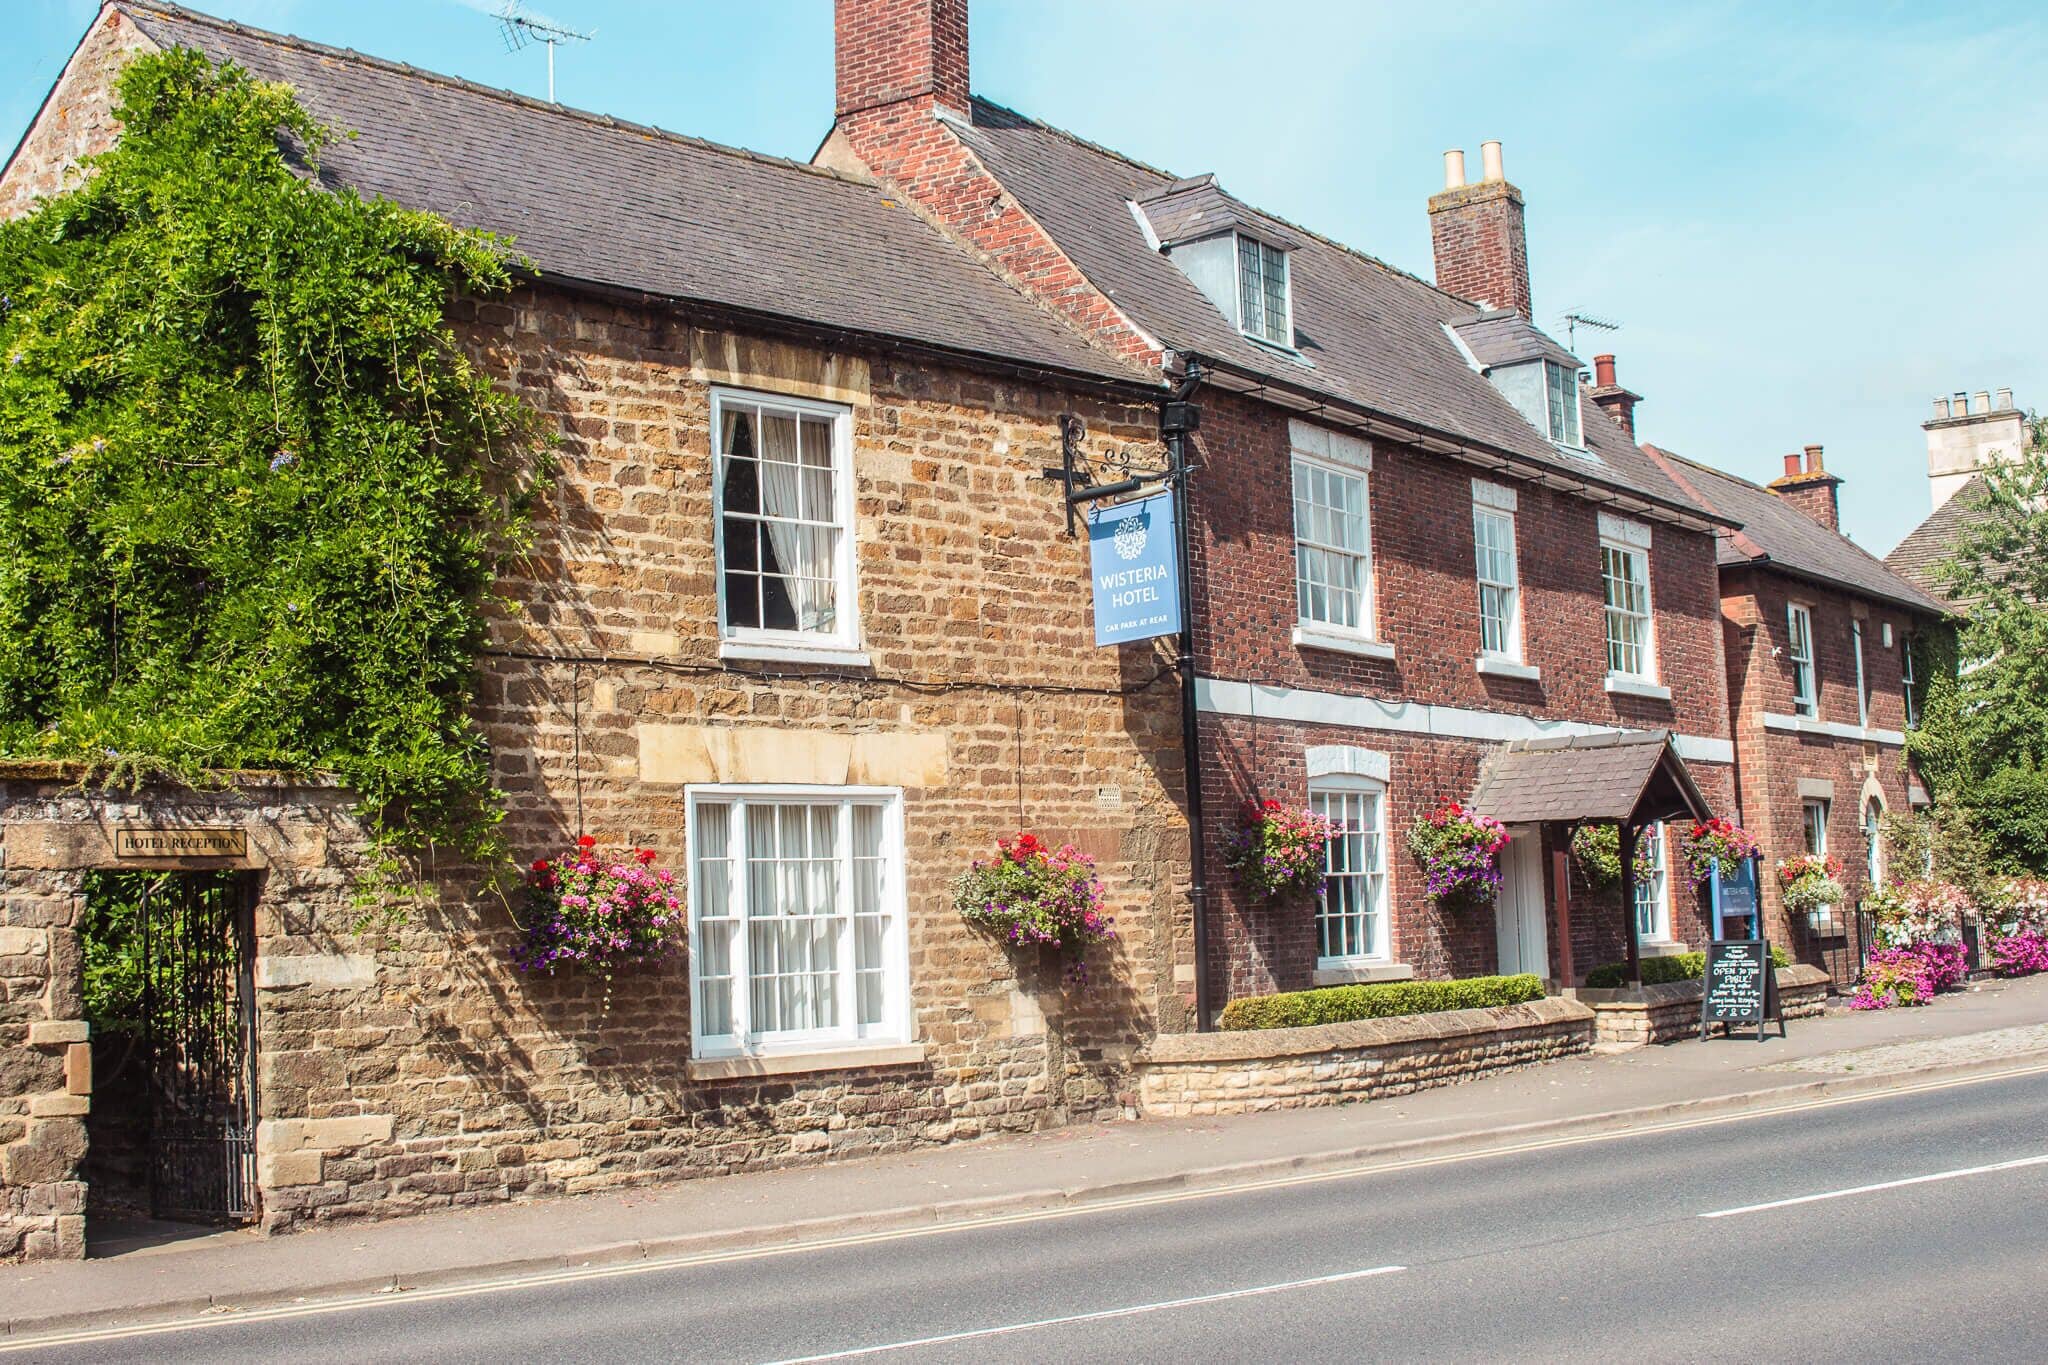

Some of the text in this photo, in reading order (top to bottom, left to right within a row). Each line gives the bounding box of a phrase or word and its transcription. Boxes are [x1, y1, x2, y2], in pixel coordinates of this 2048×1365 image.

[1100, 564, 1168, 590] WISTERIA
[1112, 586, 1159, 608] HOTEL
[1104, 615, 1168, 633] CAR PARK AT REAR
[125, 838, 240, 849] HOTEL RECEPTION
[1713, 967, 1736, 976] OPEN
